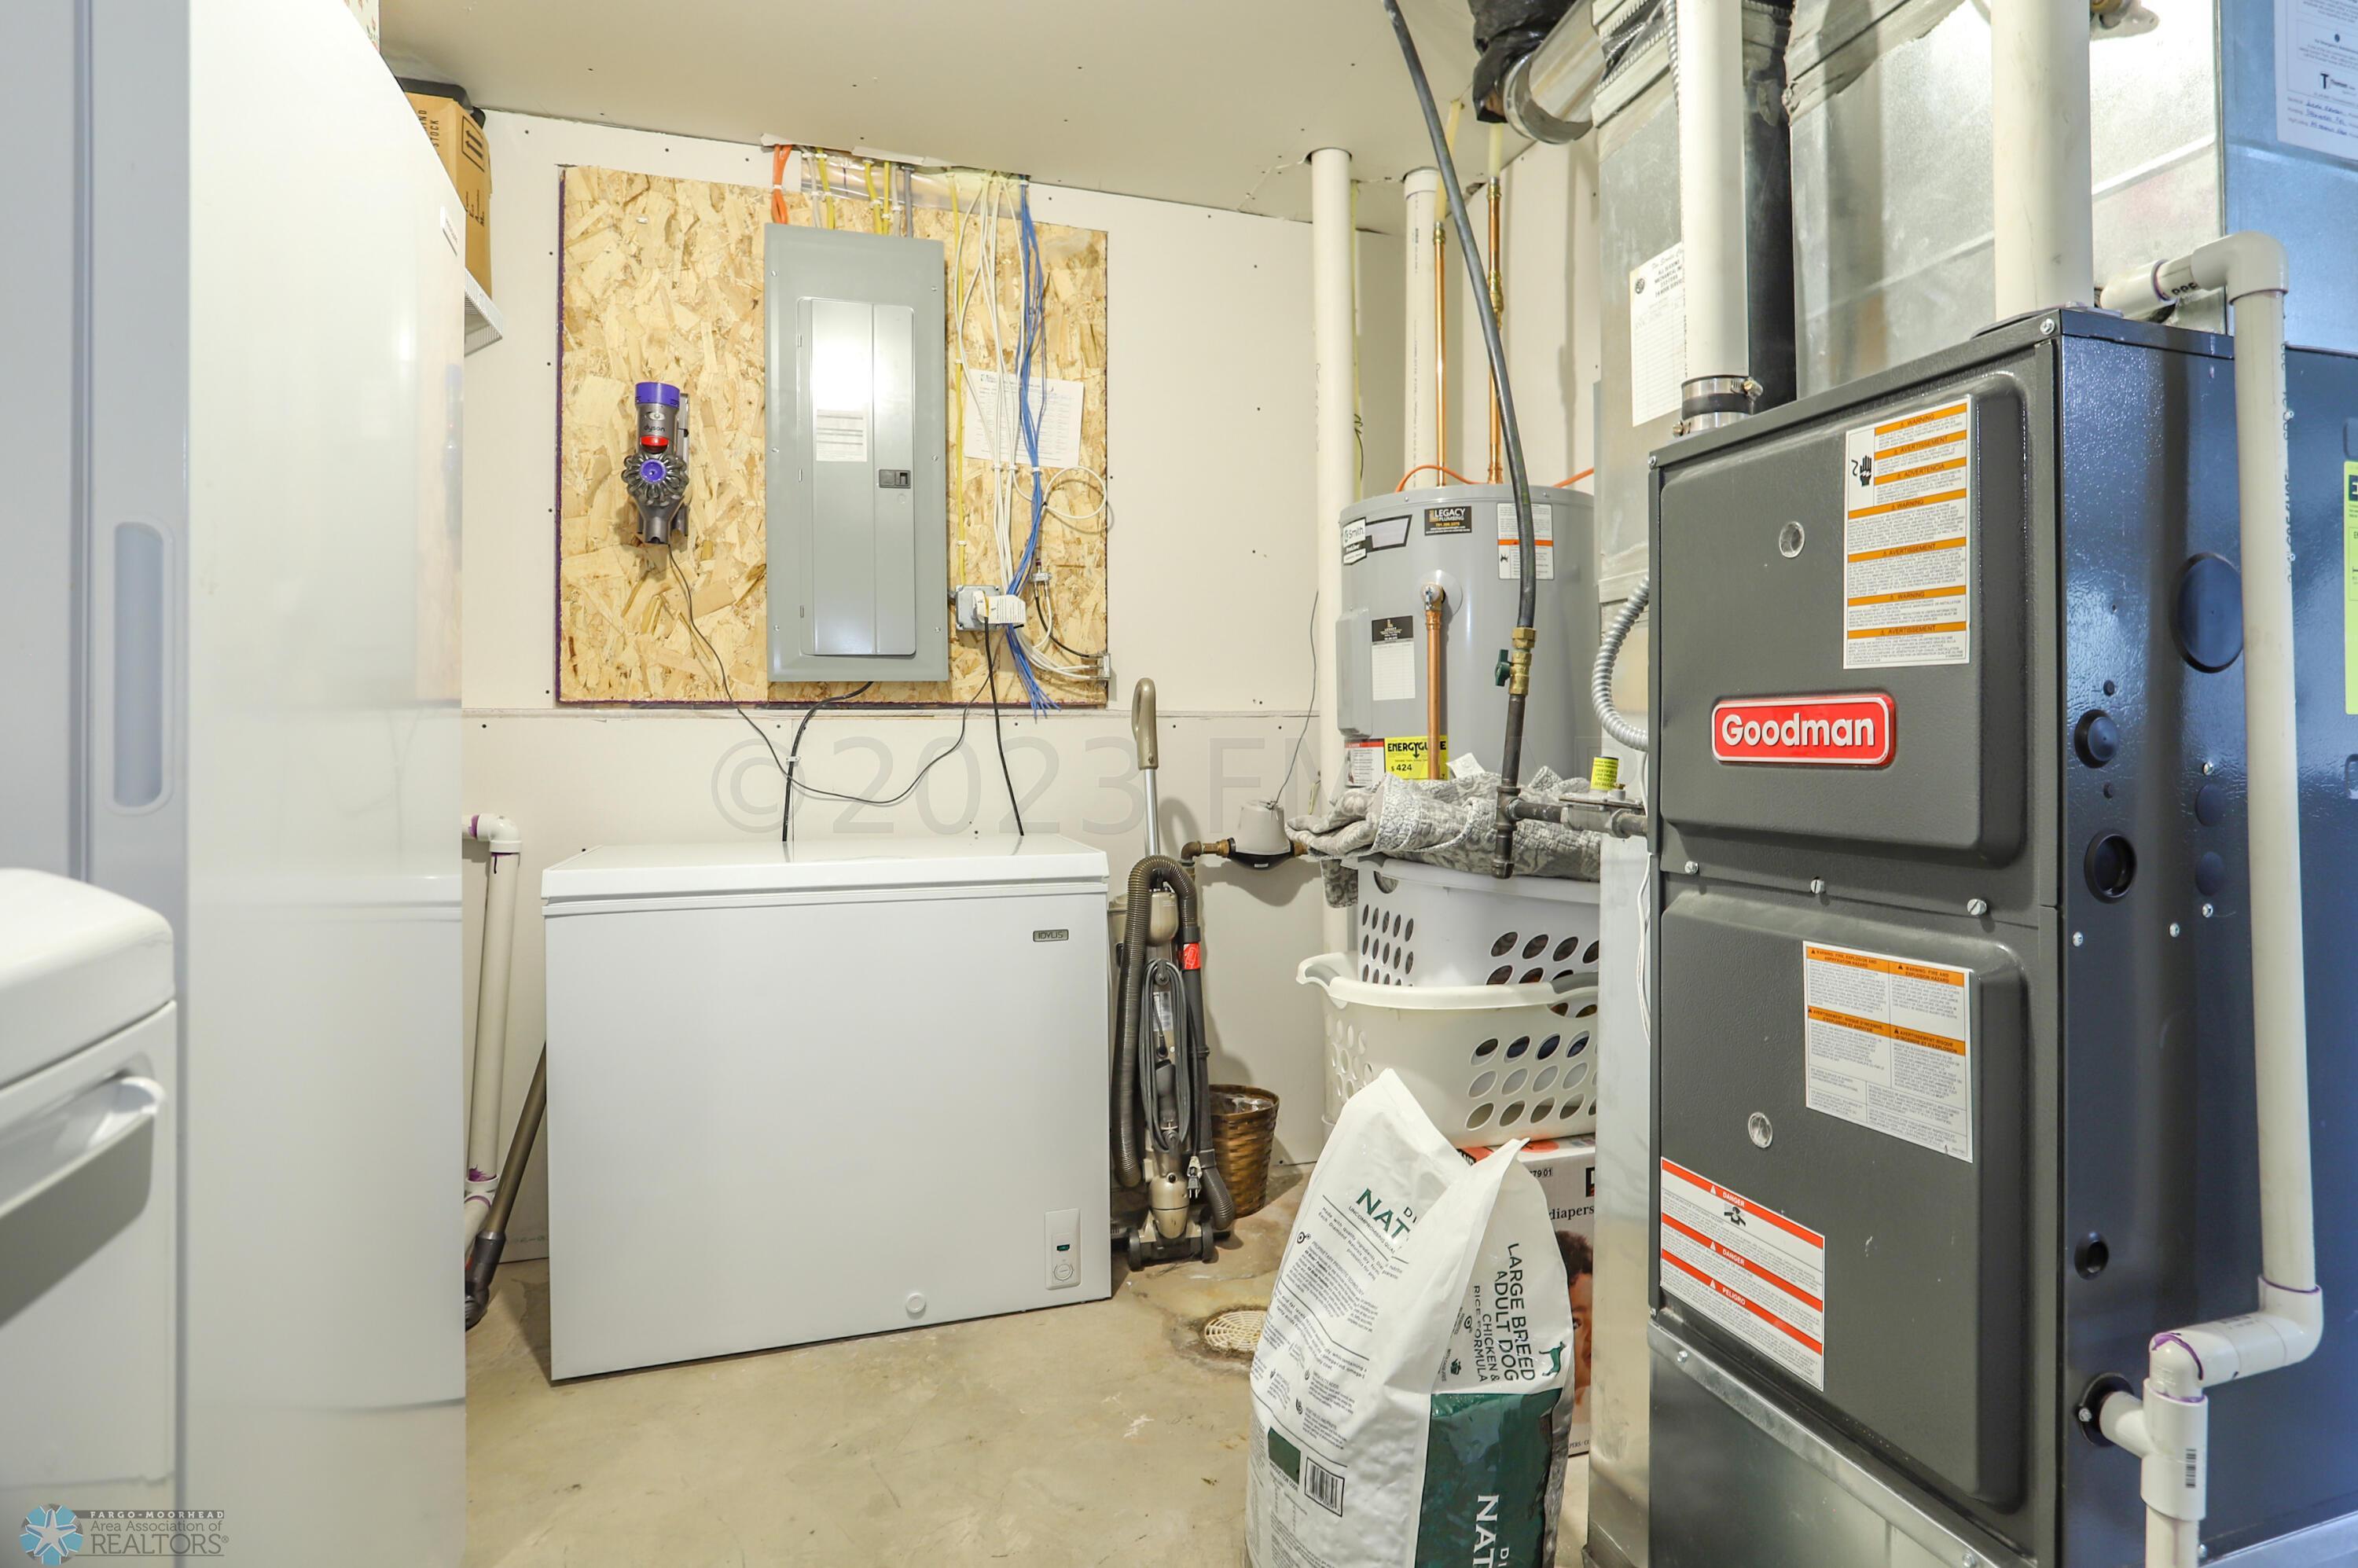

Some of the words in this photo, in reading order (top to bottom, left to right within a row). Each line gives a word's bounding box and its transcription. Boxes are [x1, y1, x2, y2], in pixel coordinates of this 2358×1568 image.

[1907, 413, 1935, 425] WARNING
[1901, 435, 1948, 452] AVERTISSEMENT
[1434, 509, 1465, 517] LEGACY
[1897, 500, 1924, 509] WARNING
[1889, 543, 1936, 556] AVERTISSEMENT
[1897, 591, 1925, 600] WARNING
[1888, 625, 1936, 635] AVERTISSEMENT
[1722, 712, 1874, 747] Goodman
[1038, 931, 1063, 939] IDYLIS
[1722, 1192, 1745, 1207] DANGER
[1549, 1206, 1595, 1221] diapers
[1328, 1221, 1347, 1240] Diamond
[1332, 1217, 1343, 1227] with
[1342, 1226, 1357, 1241] quality
[1347, 1206, 1386, 1243] UNCOMPROMISING
[1723, 1248, 1745, 1265] DANGER
[1508, 1243, 1524, 1309] LARGE
[1494, 1271, 1511, 1332] ADULT
[1723, 1287, 1746, 1305] PELIGRO
[1482, 1313, 1497, 1371] CHICKEN
[1511, 1316, 1536, 1381] BREED
[1498, 1339, 1519, 1381] DOG
[1472, 1495, 1500, 1568] NAT
